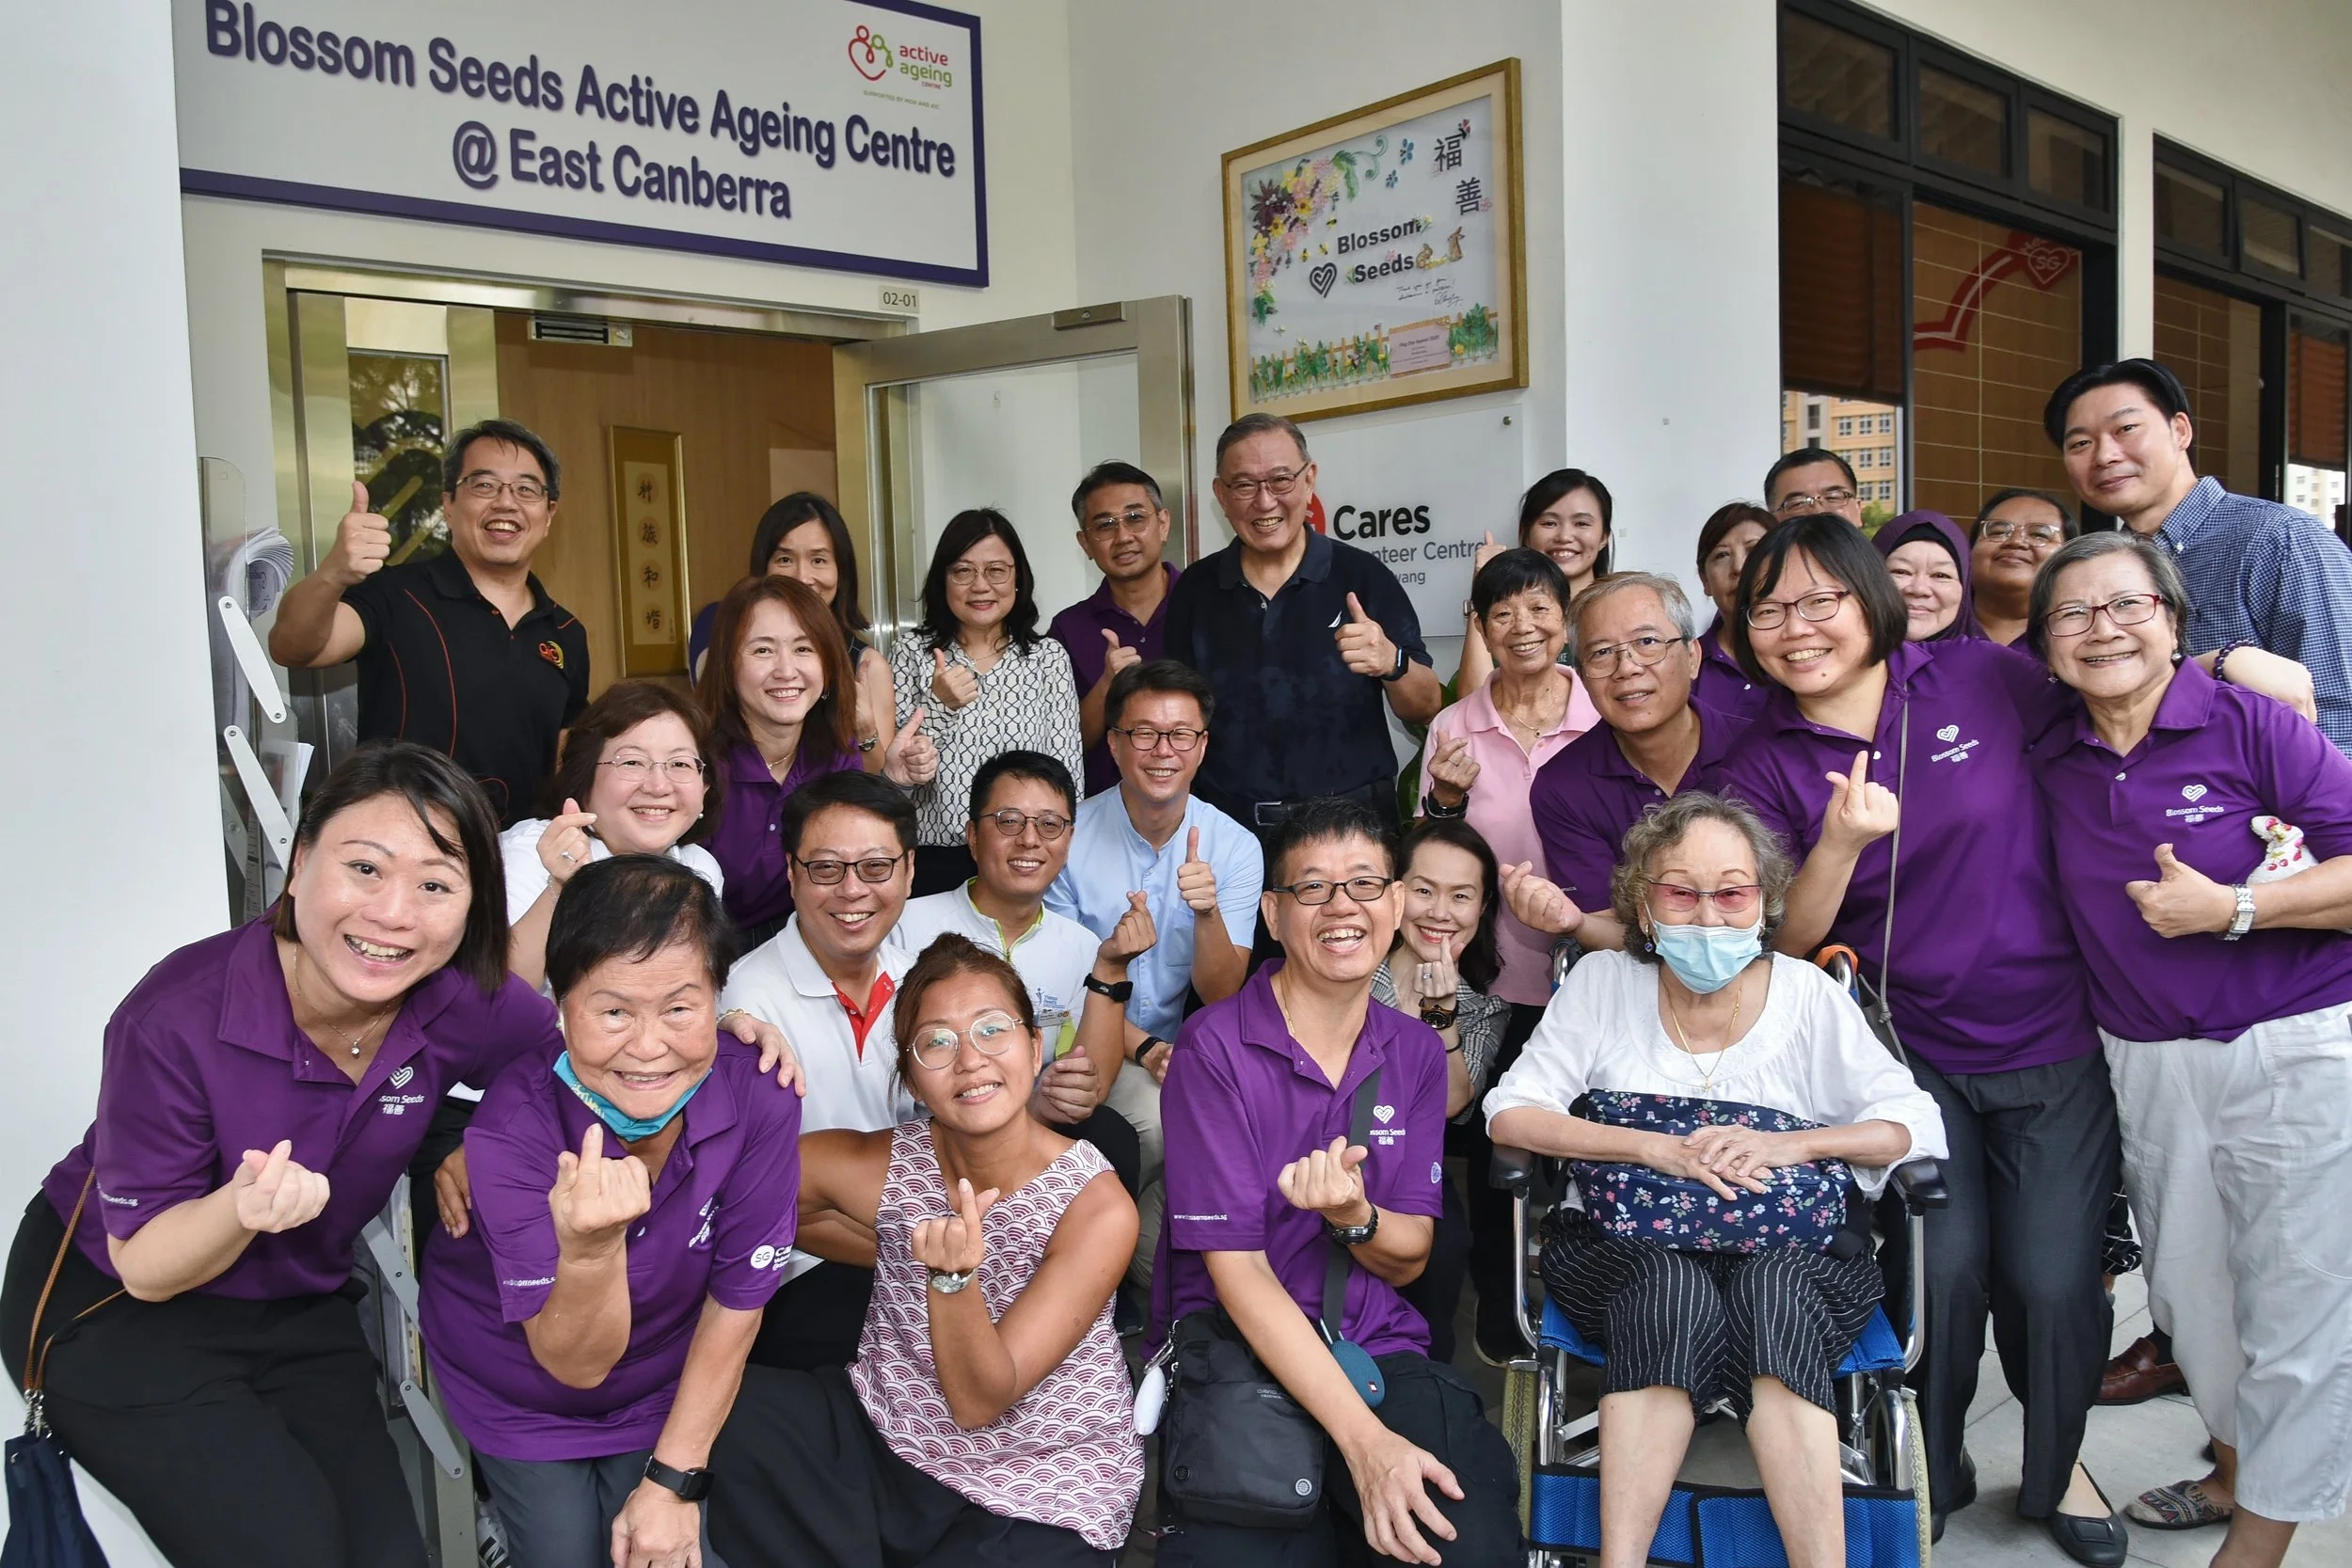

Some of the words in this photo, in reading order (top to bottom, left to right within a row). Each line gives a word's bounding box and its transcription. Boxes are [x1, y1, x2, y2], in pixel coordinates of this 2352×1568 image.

[899, 45, 949, 66] active
[899, 62, 953, 88] ageing
[205, 0, 415, 87] Blossom
[428, 38, 564, 111] Seeds
[575, 65, 700, 135] Active
[709, 90, 835, 169] Ageing
[845, 115, 956, 178] Centre
[453, 121, 499, 190] @
[509, 129, 605, 193] East
[612, 145, 791, 219] Canberra
[1354, 253, 1415, 283] Seeds
[882, 292, 916, 308] 02-01
[1333, 504, 1431, 541] Cares
[1372, 546, 1418, 564] nteer
[379, 1095, 401, 1103] som
[401, 1094, 425, 1104] Seeds
[755, 1252, 771, 1263] SG
